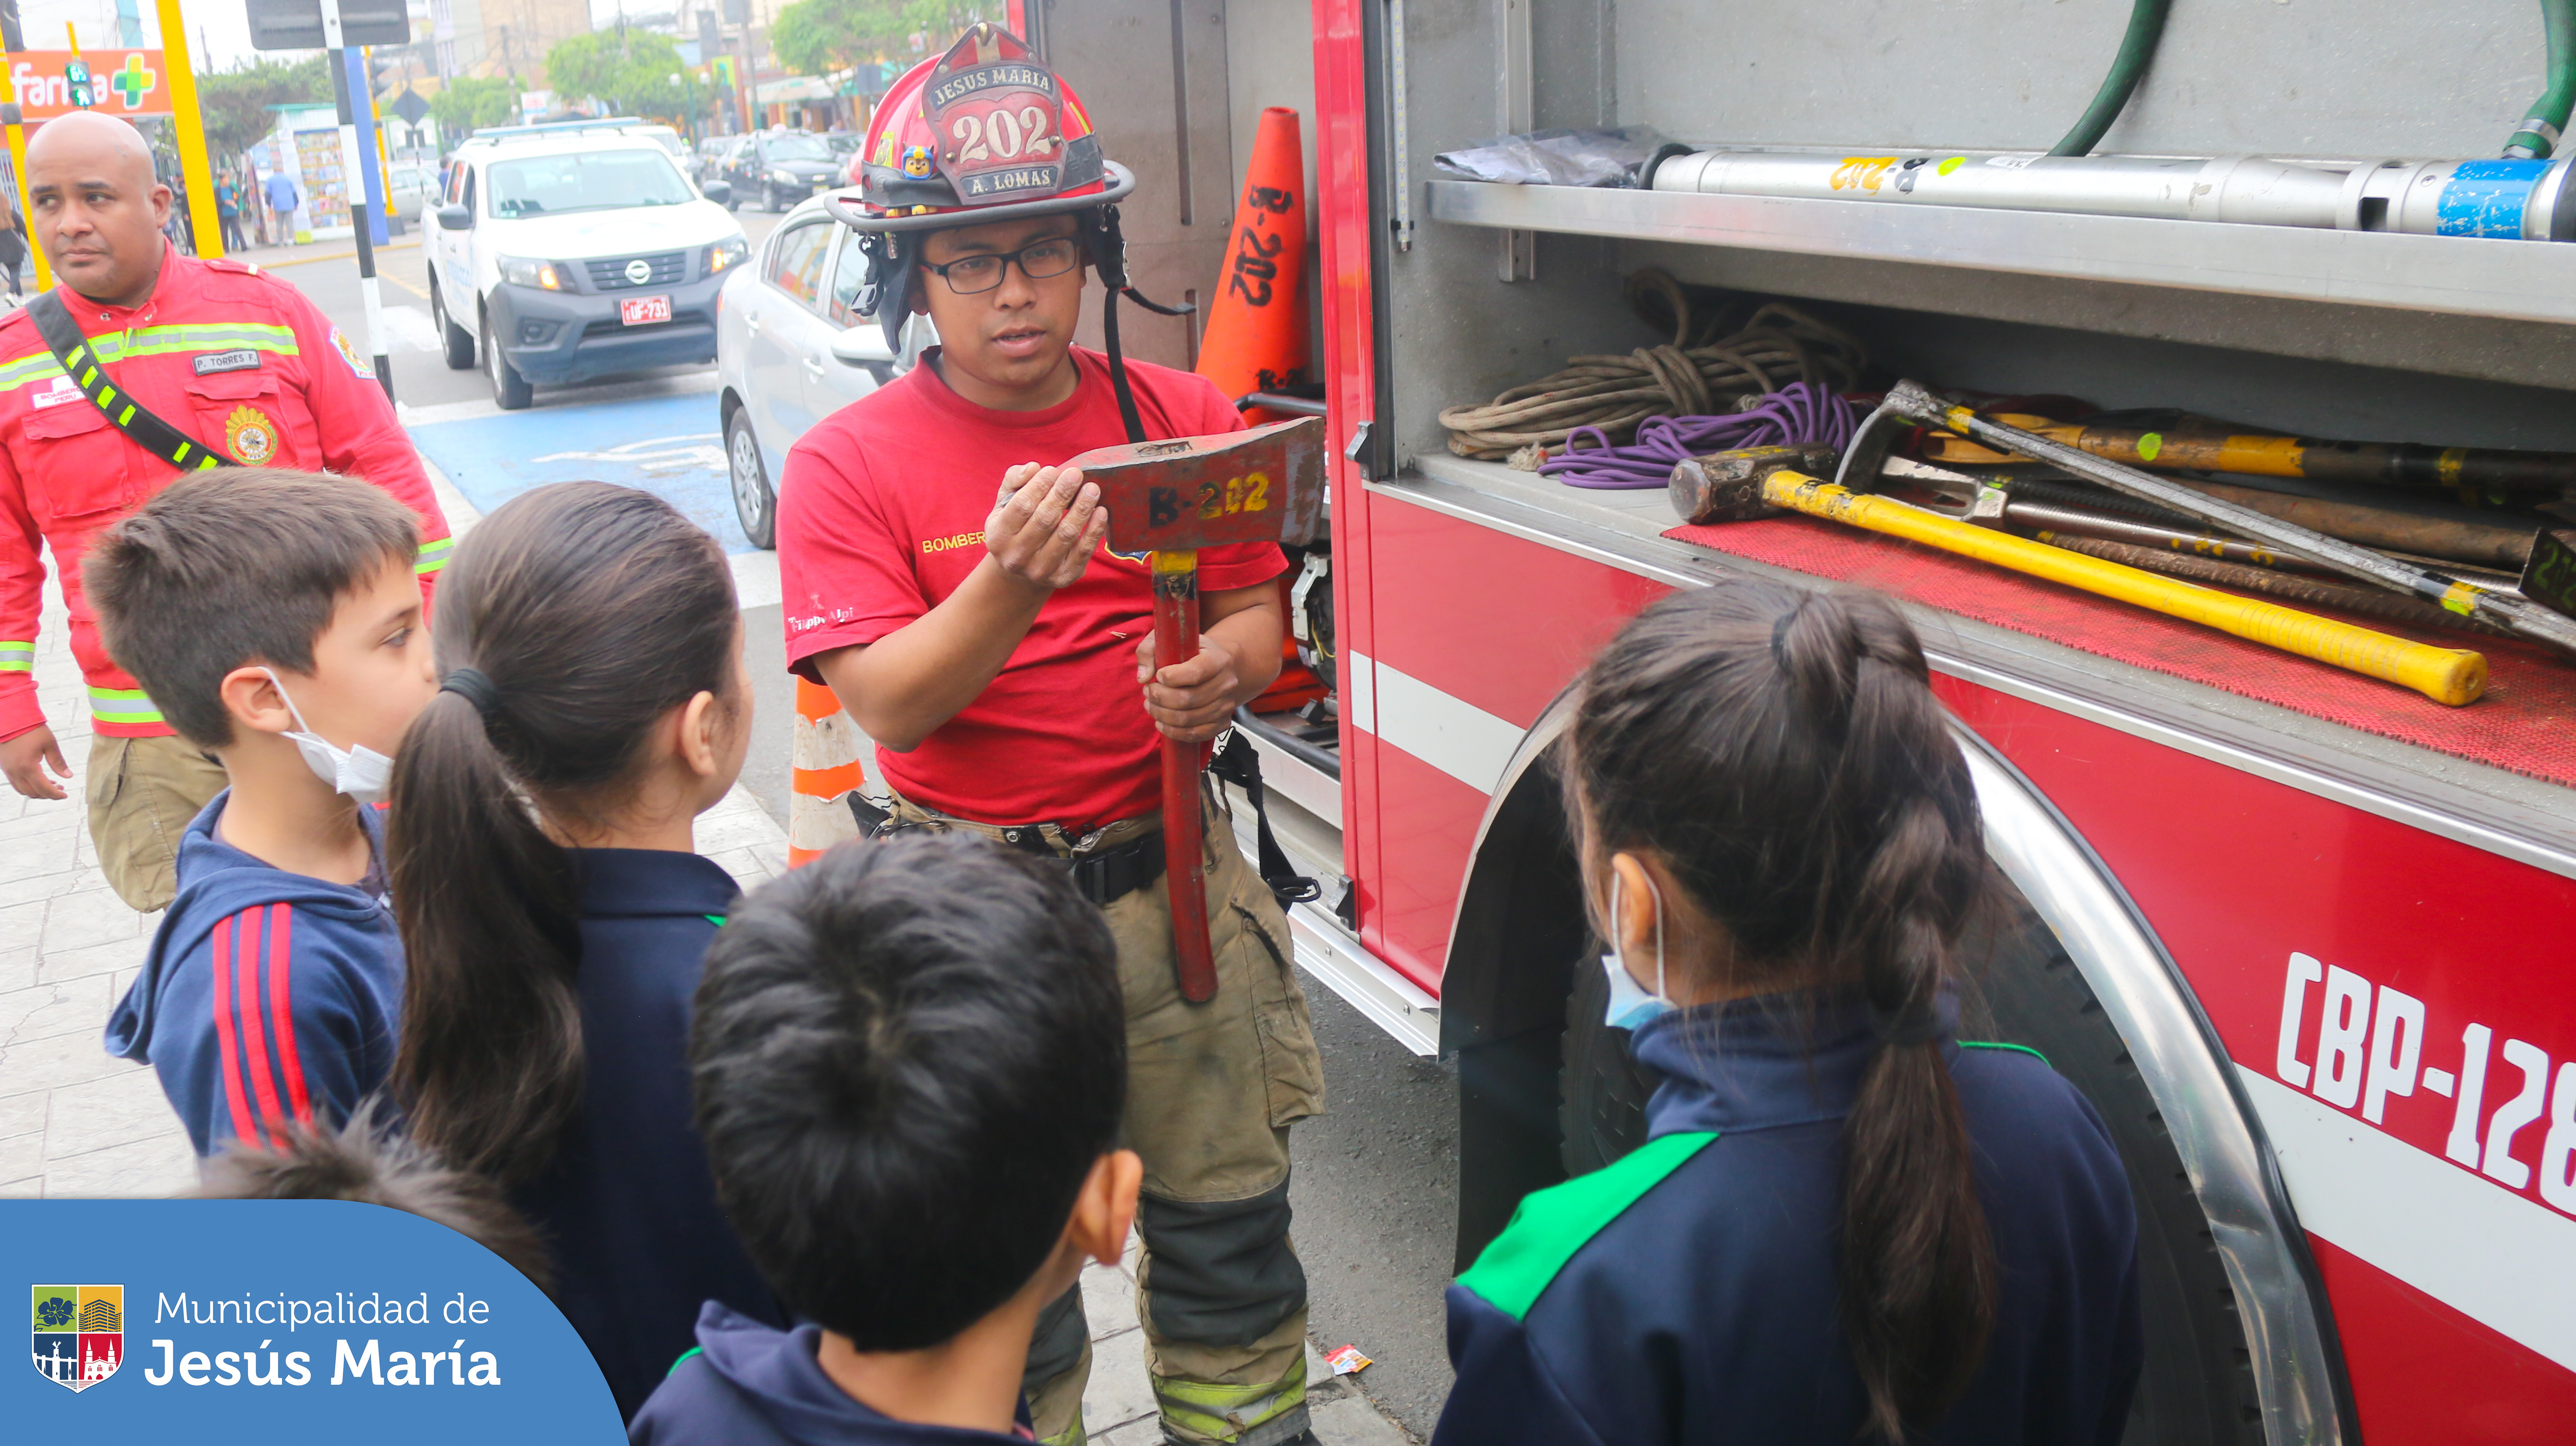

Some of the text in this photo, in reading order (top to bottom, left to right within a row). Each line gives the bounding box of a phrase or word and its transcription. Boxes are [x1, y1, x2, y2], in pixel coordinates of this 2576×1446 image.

[934, 68, 1050, 105] JESUS MARIA
[952, 106, 1051, 164] 202
[972, 169, 1051, 194] A. LOMAS
[197, 360, 206, 369] P.
[210, 354, 244, 366] TORRES
[55, 394, 76, 403] PERU
[1149, 472, 1269, 529] B-202
